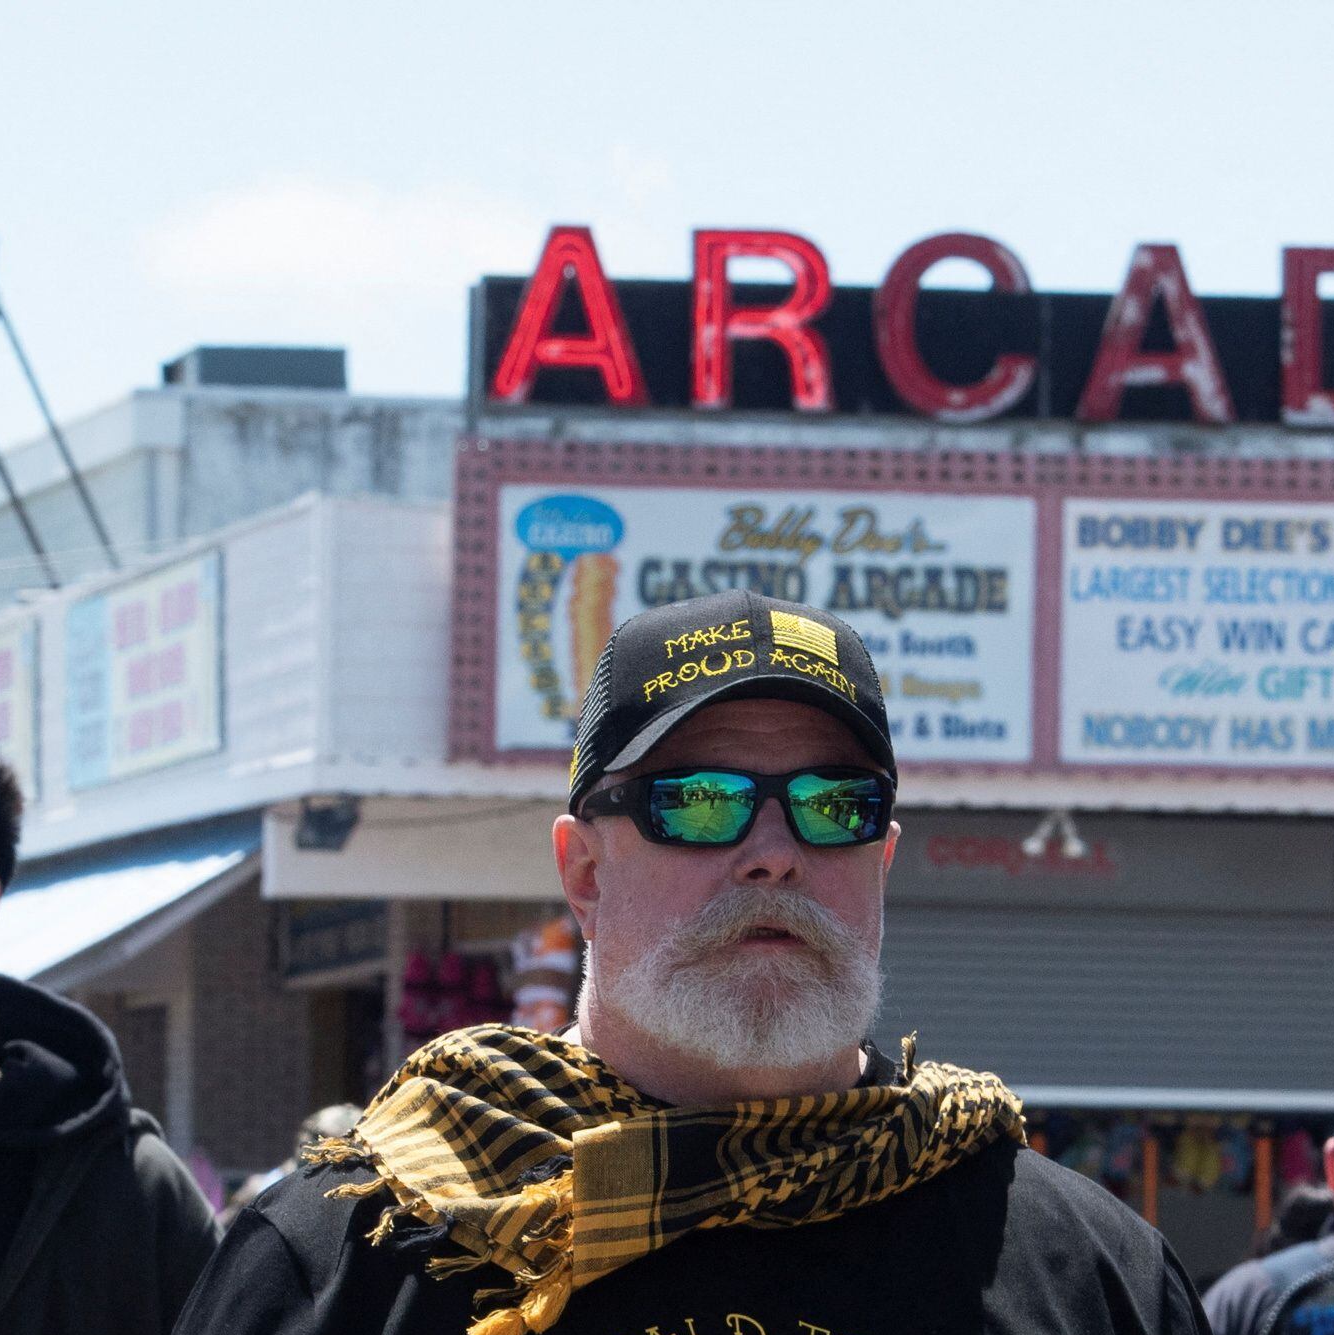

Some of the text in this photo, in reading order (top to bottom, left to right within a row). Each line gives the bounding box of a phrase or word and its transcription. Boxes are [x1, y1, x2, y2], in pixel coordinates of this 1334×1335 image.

[720, 503, 823, 562] Bobby
[1078, 516, 1205, 551] BOBBY
[1220, 520, 1332, 554] DEE'S
[825, 563, 1009, 619] ARCADE
[1069, 568, 1192, 601] LARGEST
[665, 619, 751, 658] MAKE
[1116, 616, 1204, 652] EASY
[1216, 618, 1286, 653] WIN
[643, 648, 755, 703] PROUD
[770, 648, 857, 703] AGAIN
[1082, 714, 1217, 750] NOBODY
[1228, 715, 1294, 750] HAS
